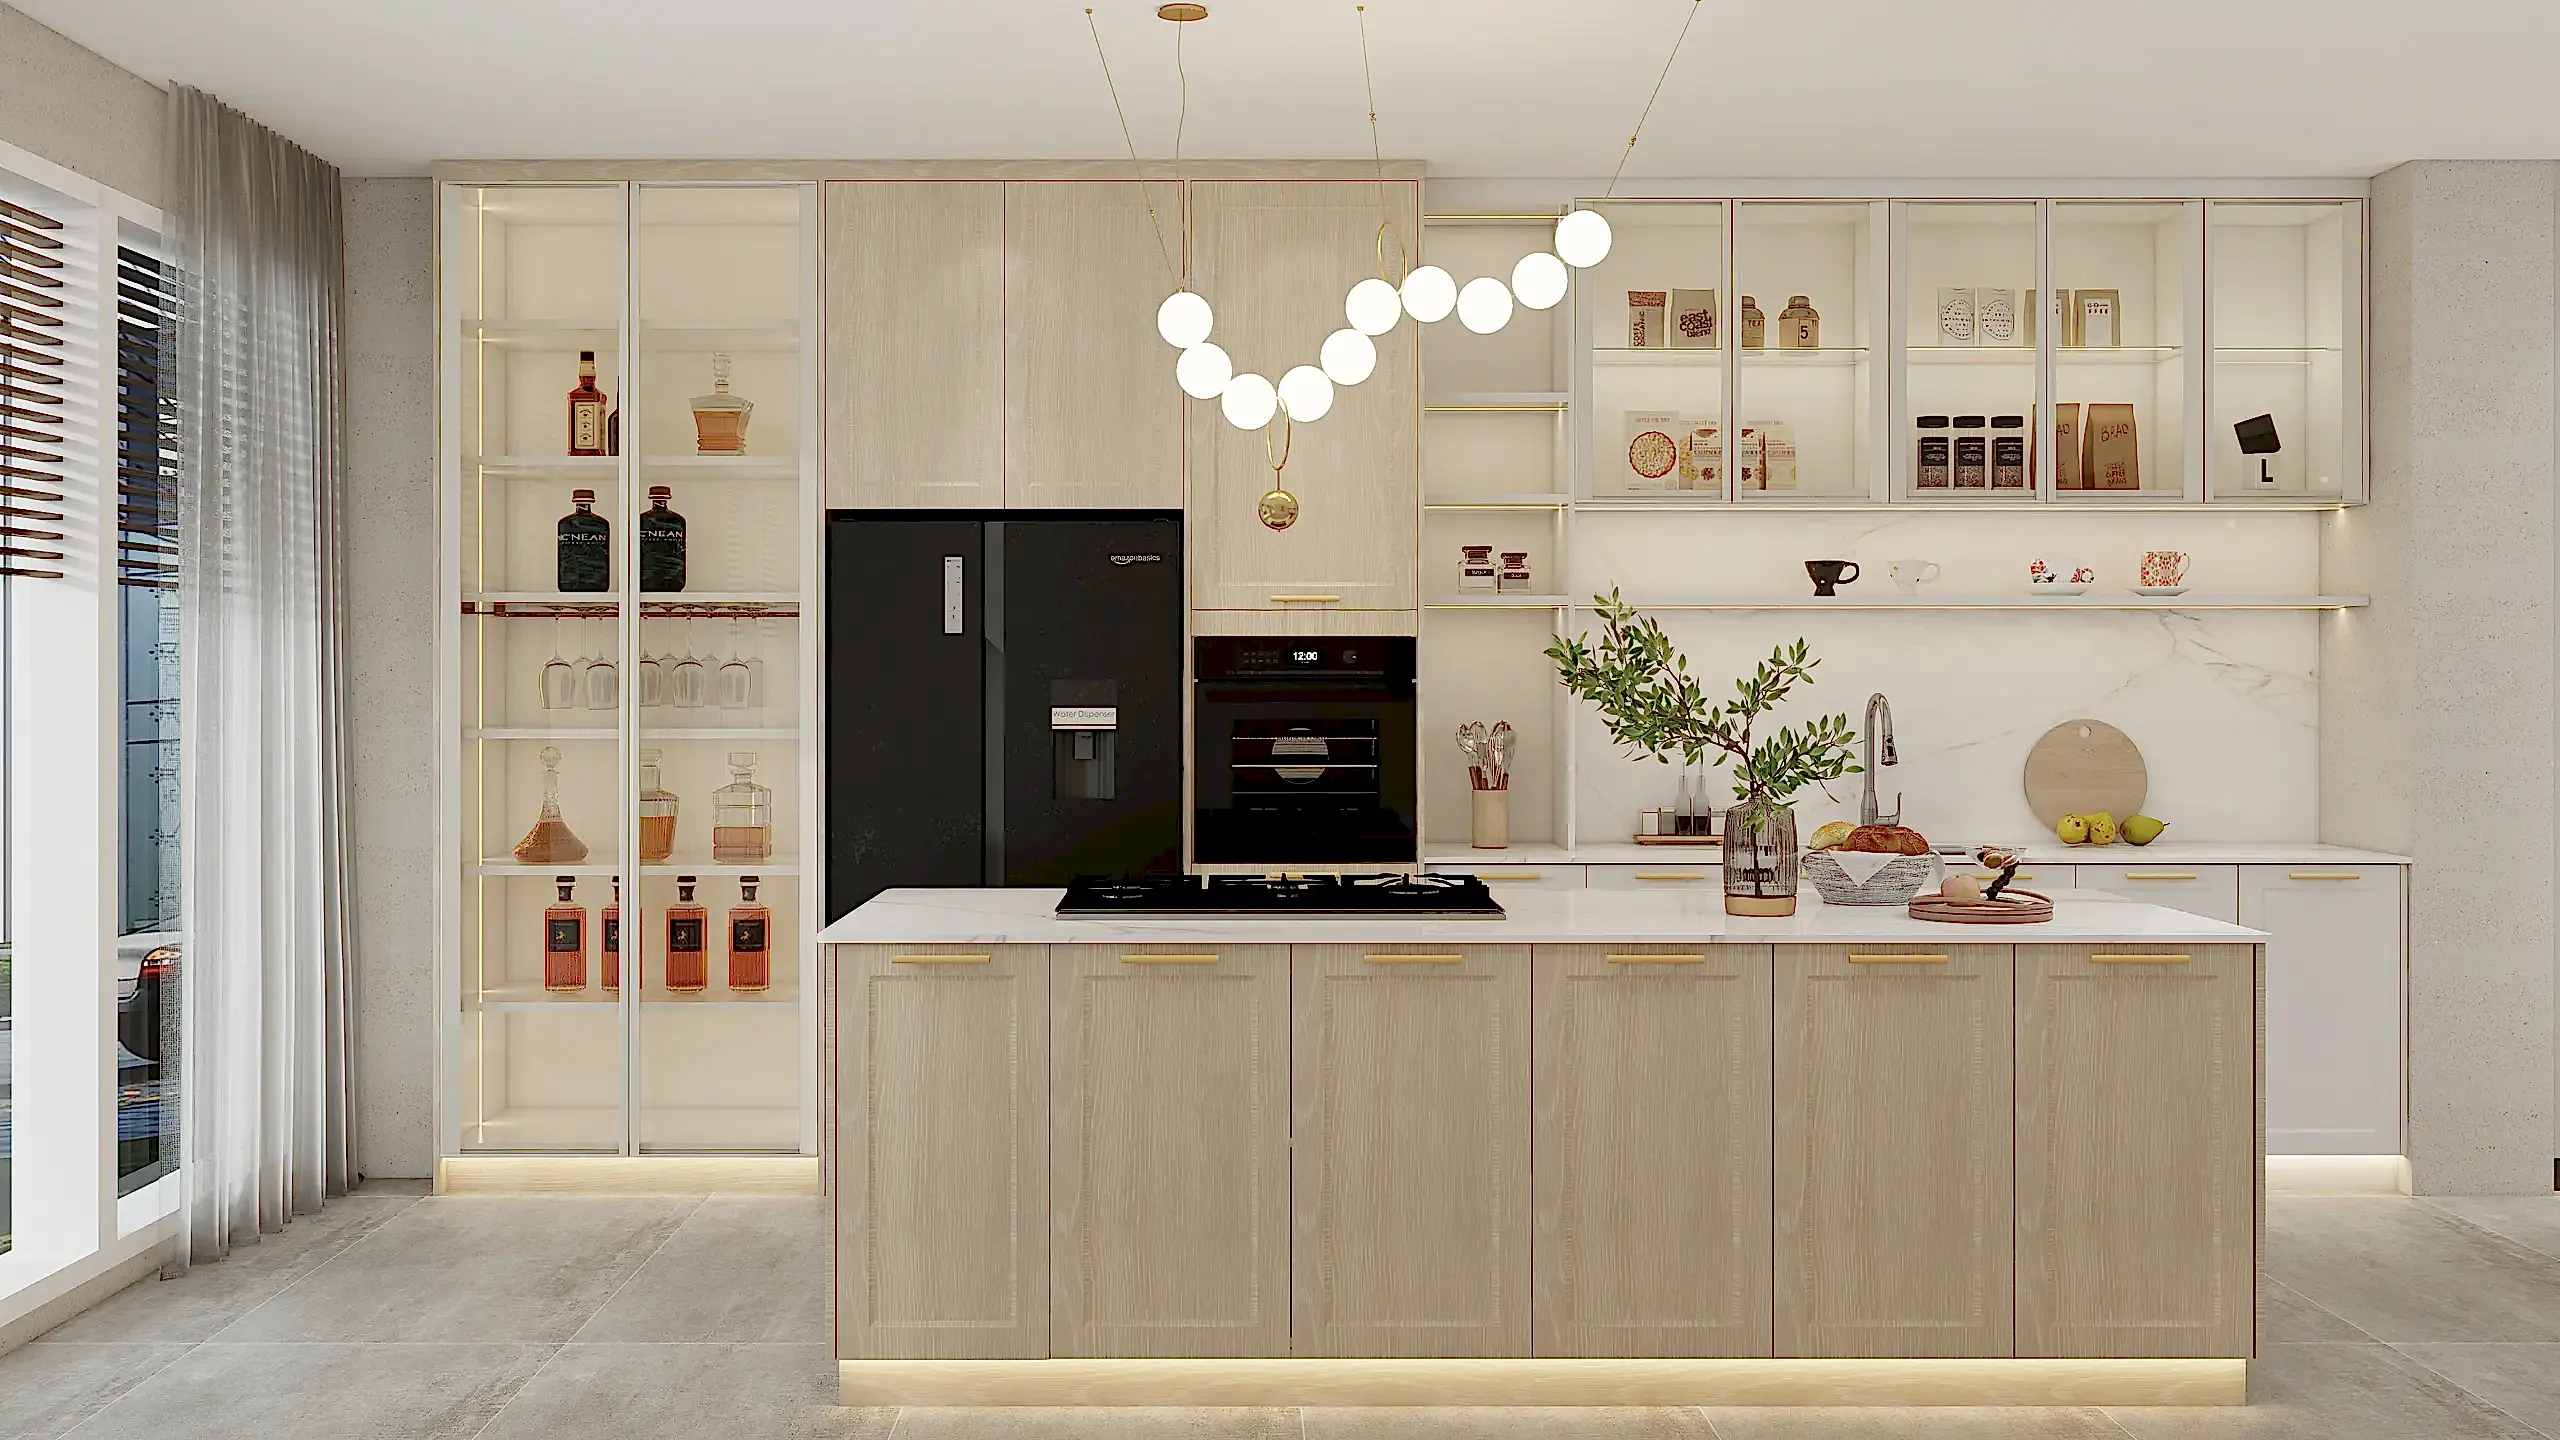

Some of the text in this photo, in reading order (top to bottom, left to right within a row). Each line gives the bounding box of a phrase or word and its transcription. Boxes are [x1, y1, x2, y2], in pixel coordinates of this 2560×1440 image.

[1680, 309, 1709, 322] east
[1680, 316, 1712, 331] coast
[1686, 329, 1711, 338] blend
[1800, 325, 1809, 339] 5
[2261, 459, 2274, 483] L
[1292, 651, 1318, 661] 12:00
[1053, 710, 1115, 719] Water Dispenser
